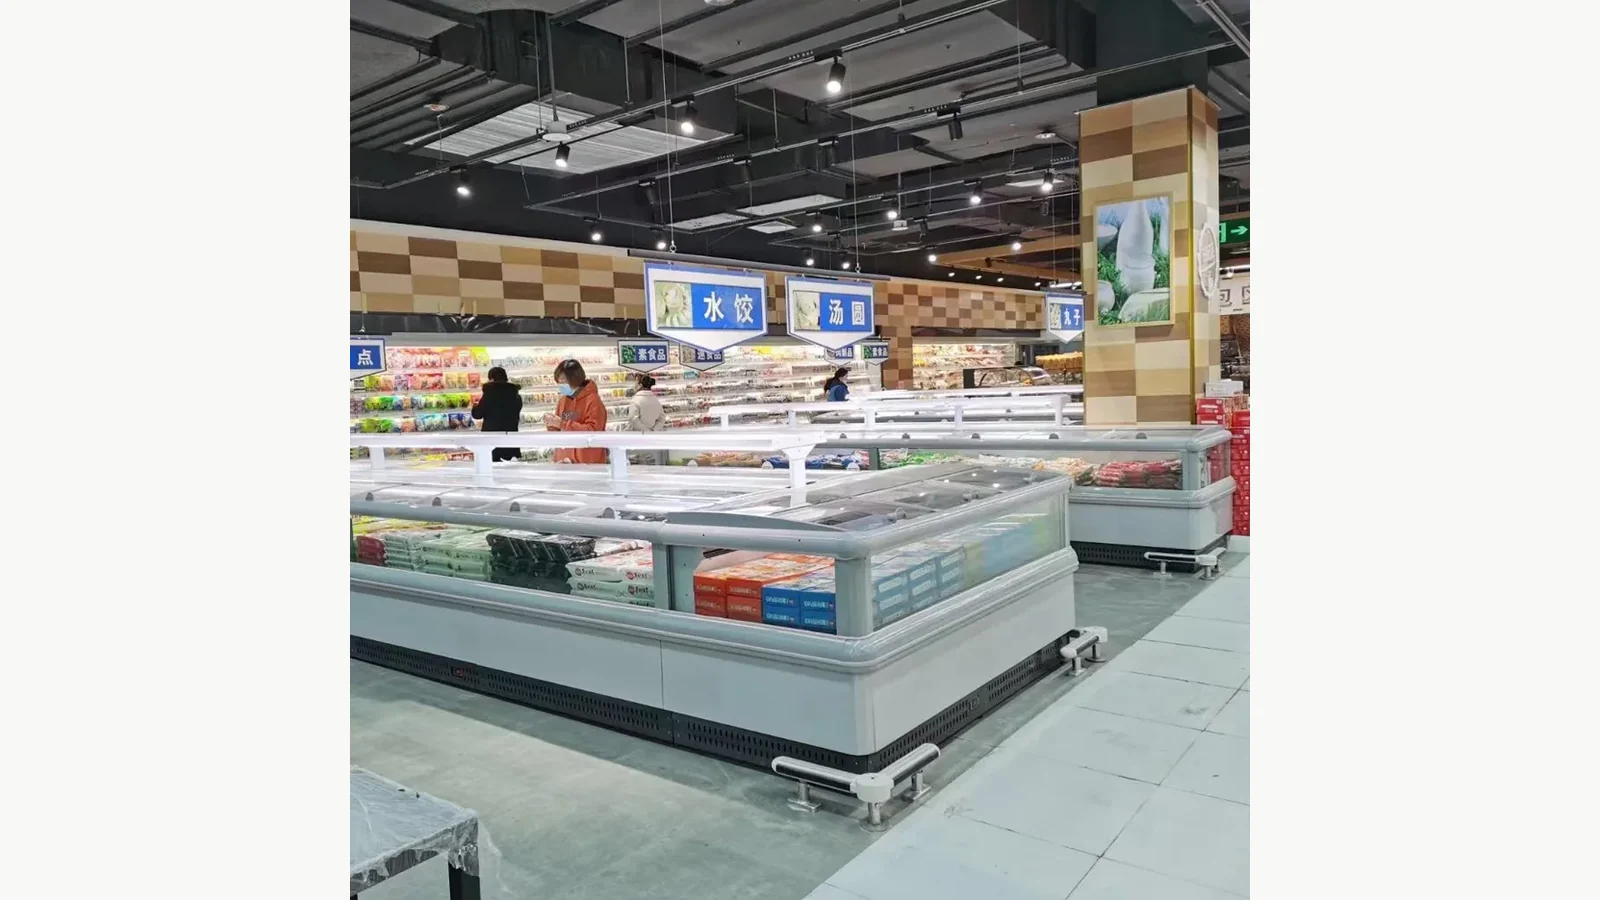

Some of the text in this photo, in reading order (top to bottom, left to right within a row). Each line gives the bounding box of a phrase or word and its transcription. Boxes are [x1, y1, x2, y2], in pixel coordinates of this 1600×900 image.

[703, 291, 753, 323] 水饺
[829, 298, 865, 325] 汤圆
[1064, 307, 1080, 326] 丸子
[357, 348, 373, 366] 点
[638, 347, 666, 361] 素食品
